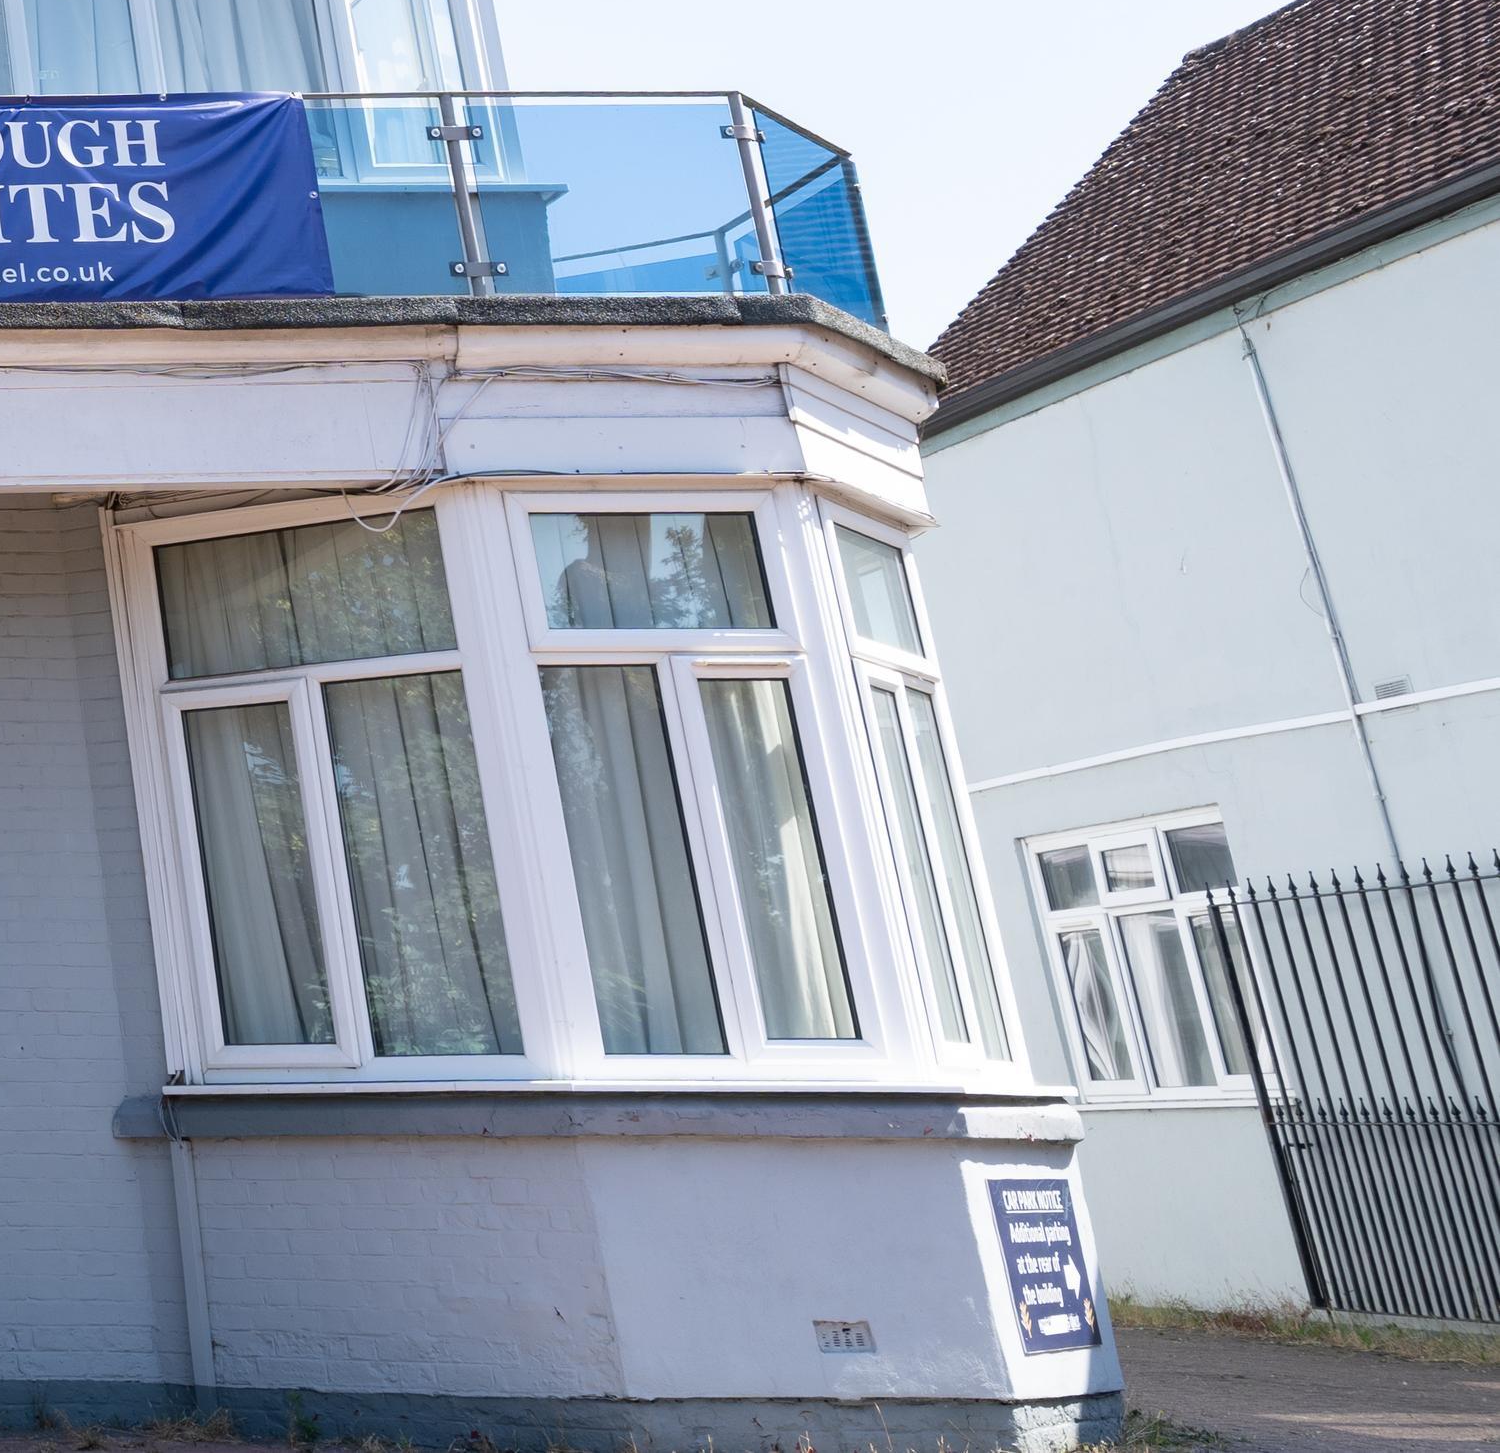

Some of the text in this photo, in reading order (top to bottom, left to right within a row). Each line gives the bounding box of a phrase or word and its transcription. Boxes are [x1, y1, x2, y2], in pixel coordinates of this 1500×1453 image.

[1002, 1190, 1064, 1211] CAR PARK NOTICE
[1009, 1221, 1072, 1246] Additional parking
[1016, 1251, 1061, 1274] at the rear of
[1023, 1283, 1064, 1307] the building
